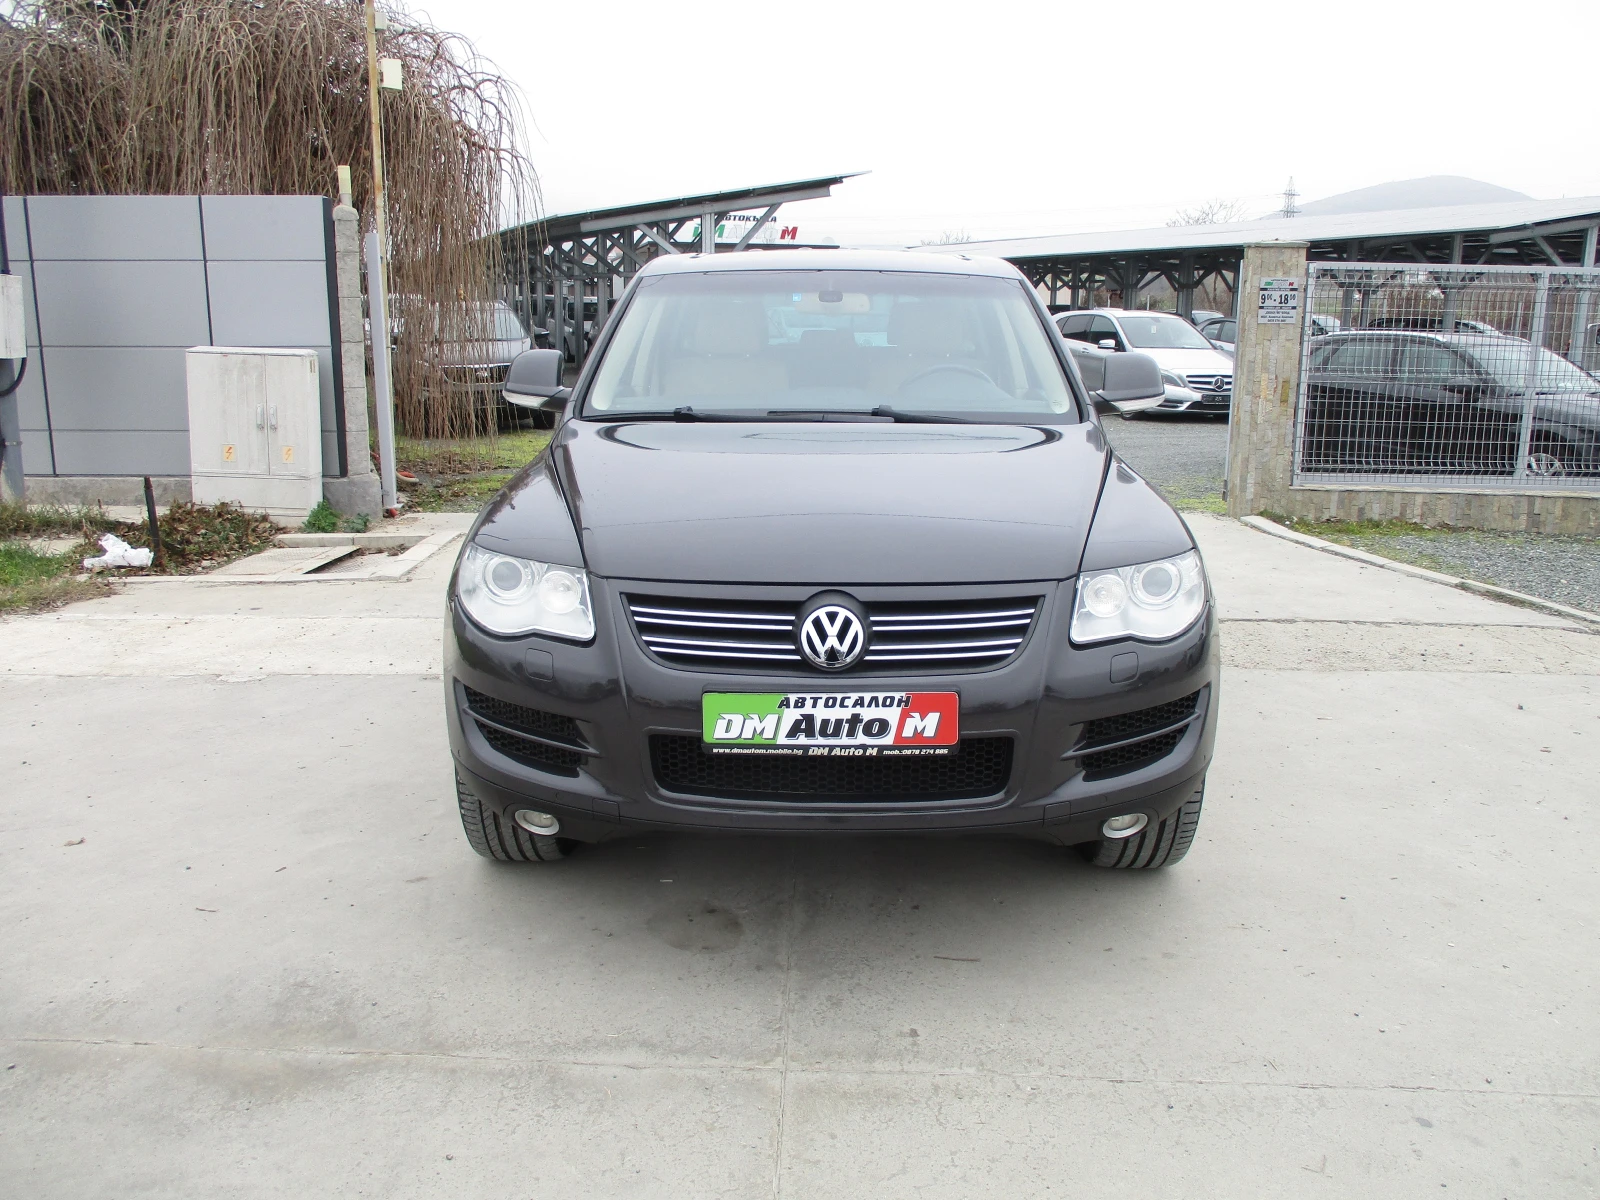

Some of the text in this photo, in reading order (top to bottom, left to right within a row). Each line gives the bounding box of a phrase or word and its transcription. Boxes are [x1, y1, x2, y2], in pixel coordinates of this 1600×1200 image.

[718, 214, 777, 223] ВТОКЪА
[780, 226, 799, 240] M
[777, 695, 913, 709] АВТОСАЛОН
[713, 712, 942, 740] DM Auto M
[808, 746, 879, 756] DM Auto M
